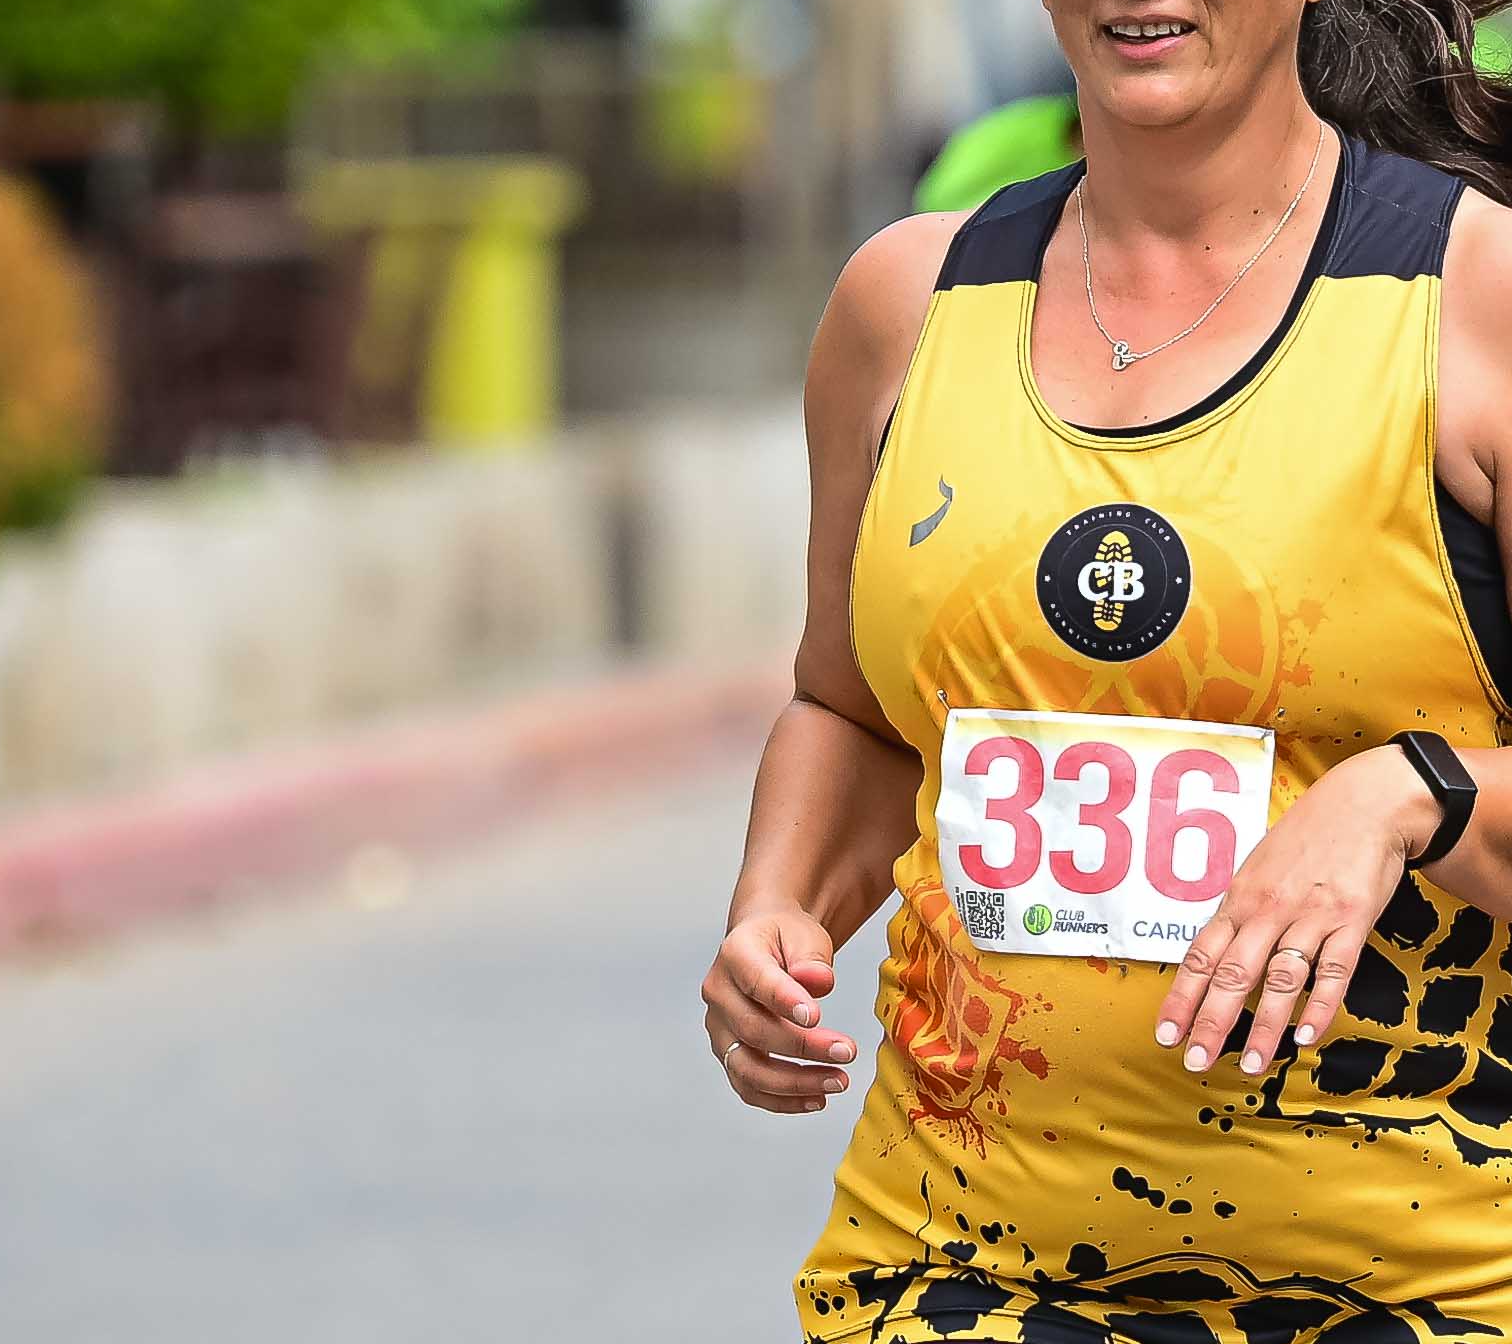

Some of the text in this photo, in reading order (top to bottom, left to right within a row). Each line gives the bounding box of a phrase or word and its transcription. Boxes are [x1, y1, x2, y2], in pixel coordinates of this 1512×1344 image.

[1077, 560, 1145, 602] CB
[958, 736, 1240, 902] 336
[1056, 909, 1085, 921] CLUB
[1133, 920, 1197, 942] CARU
